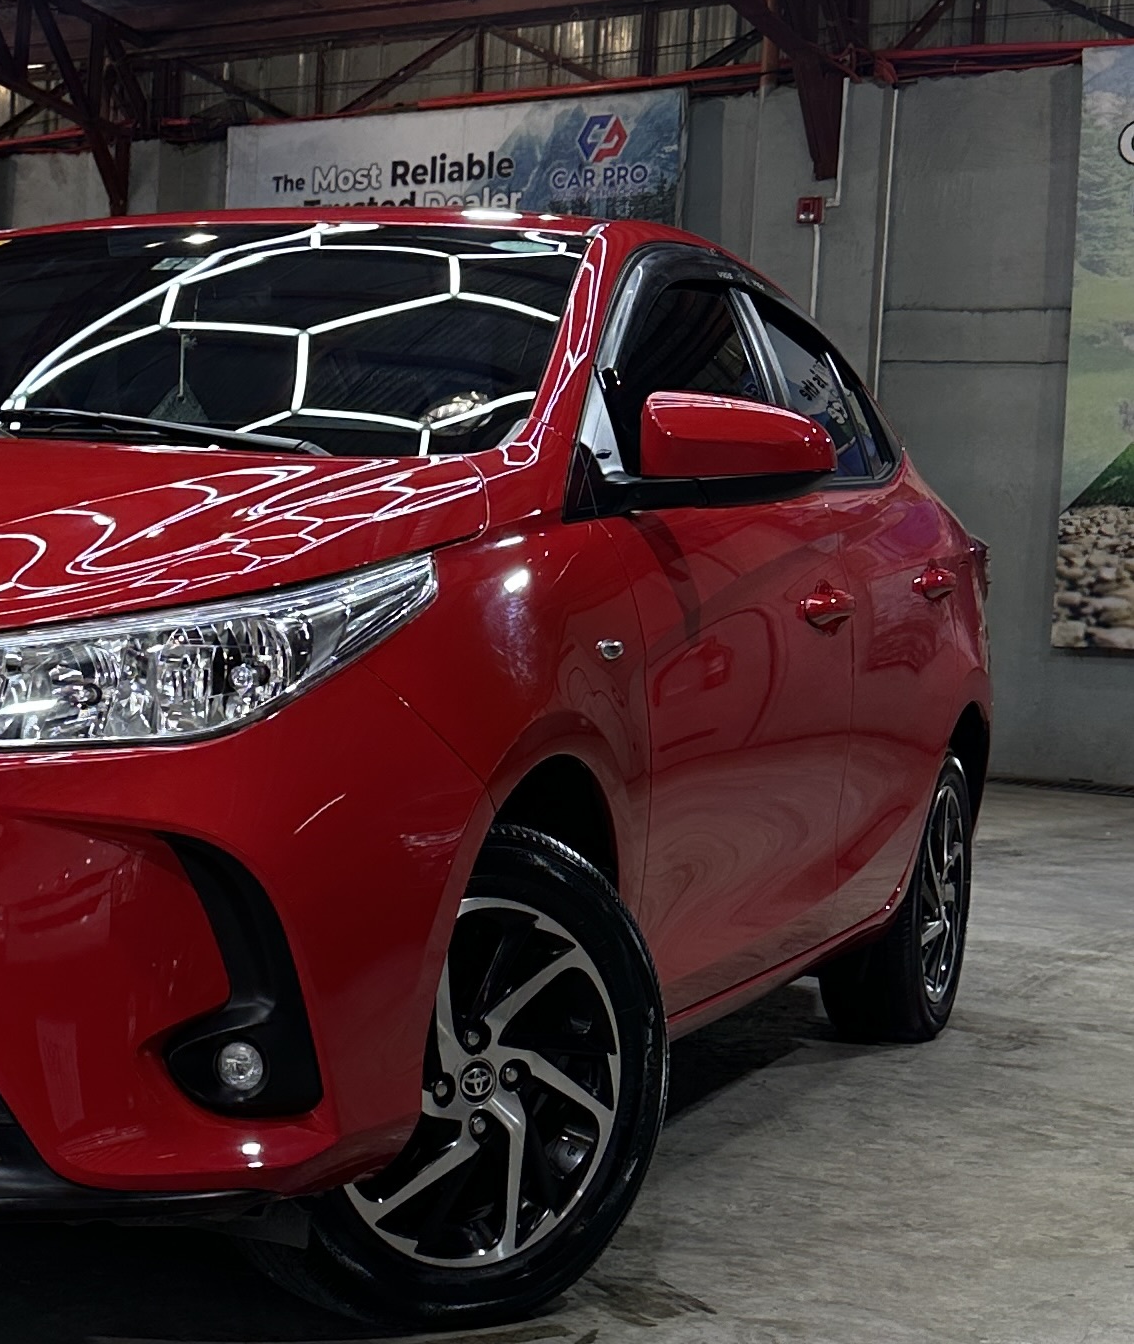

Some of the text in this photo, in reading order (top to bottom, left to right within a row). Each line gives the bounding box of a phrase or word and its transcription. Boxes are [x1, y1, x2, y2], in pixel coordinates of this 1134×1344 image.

[273, 151, 514, 195] The Most Reliable
[552, 164, 648, 189] CAR PRO
